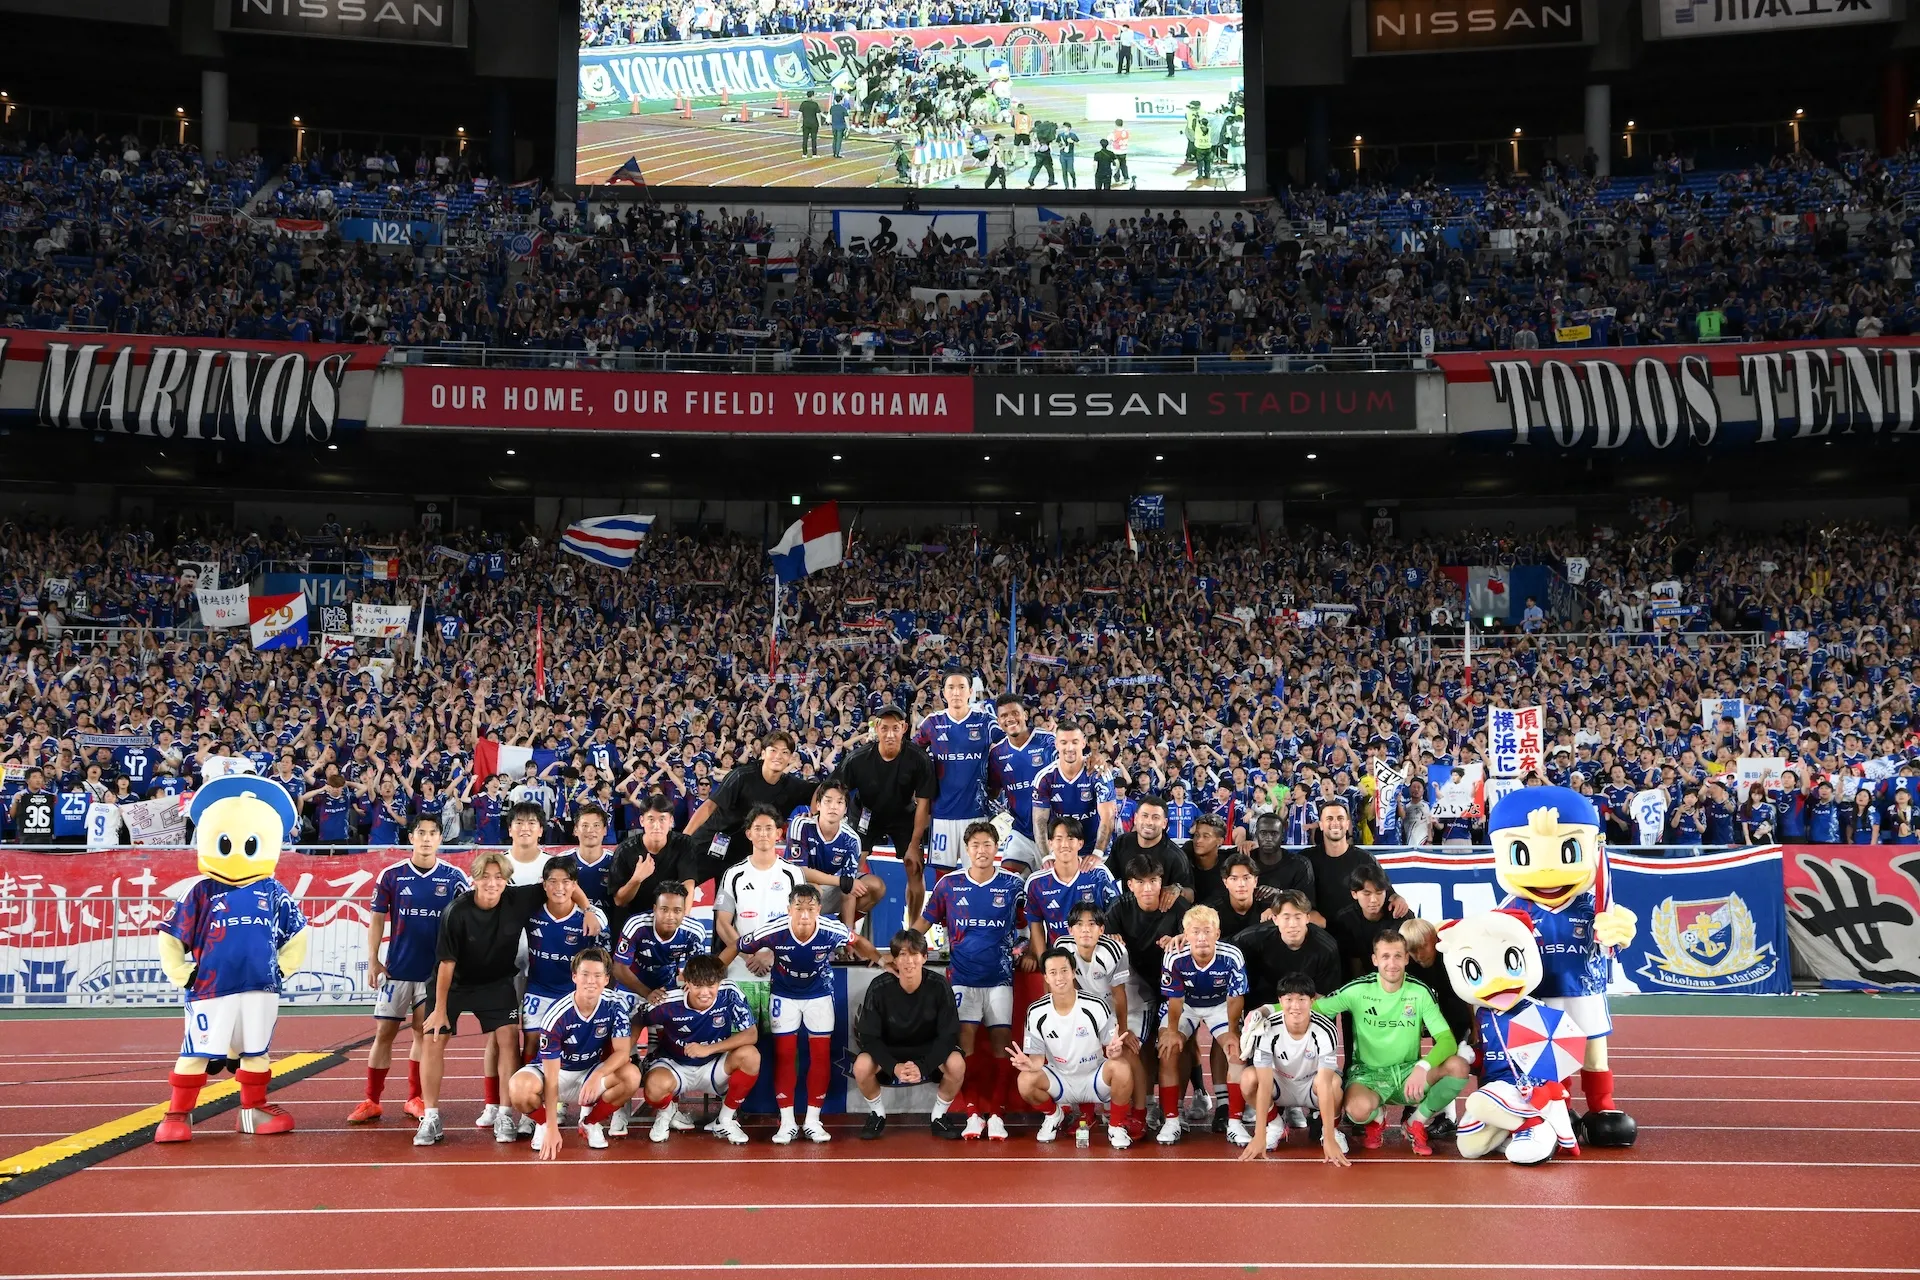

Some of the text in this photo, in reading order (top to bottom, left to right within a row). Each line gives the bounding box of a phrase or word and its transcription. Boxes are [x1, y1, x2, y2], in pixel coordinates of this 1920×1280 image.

[242, 0, 442, 26] NISSAN
[1376, 5, 1572, 36] NISSAN
[610, 50, 779, 101] YOKOHAMA
[372, 221, 411, 244] N24
[1401, 230, 1442, 253] N2
[1707, 317, 1713, 329] 1
[1424, 335, 1431, 347] 8
[38, 342, 352, 446] MARINOS
[431, 384, 949, 417] OUR HOME, OUR FIELD! YOKOHAMA
[995, 390, 1395, 417] NISSAN STADIUM
[1490, 354, 1720, 450] TODOS
[1570, 563, 1582, 574] 27
[51, 584, 66, 599] 28
[301, 578, 347, 606] N14
[263, 605, 294, 627] 29
[442, 621, 458, 636] 47
[88, 736, 119, 744] TRICOLORE
[1492, 710, 1517, 773] 横浜に
[1516, 708, 1540, 771] 頂点を
[124, 755, 148, 777] 47
[937, 752, 982, 761] NISSAN
[1744, 771, 1779, 779] 喜田に
[1006, 779, 1036, 792] NISSA
[61, 793, 86, 815] 25
[1433, 803, 1481, 815] かいな
[1640, 801, 1662, 825] 25
[25, 804, 50, 828] 36
[95, 815, 106, 836] 9
[932, 833, 948, 852] 40
[210, 916, 272, 931] NISSAN
[529, 918, 549, 926] DRAFT
[955, 918, 1006, 928] NISSAN
[1050, 920, 1069, 929] NIS
[1568, 917, 1589, 925] DRAFT
[1788, 850, 1920, 986] 世
[563, 925, 584, 933] DRAFT
[1539, 943, 1590, 955] ISSAN
[1658, 962, 1770, 988] Yokohama Marinos
[772, 998, 782, 1018] 8
[1362, 994, 1382, 1003] DRAFT
[196, 1012, 209, 1032] 0
[565, 1022, 582, 1030] DAFT
[593, 1016, 611, 1024] DRAFT
[1363, 1017, 1416, 1028] NISSAN
